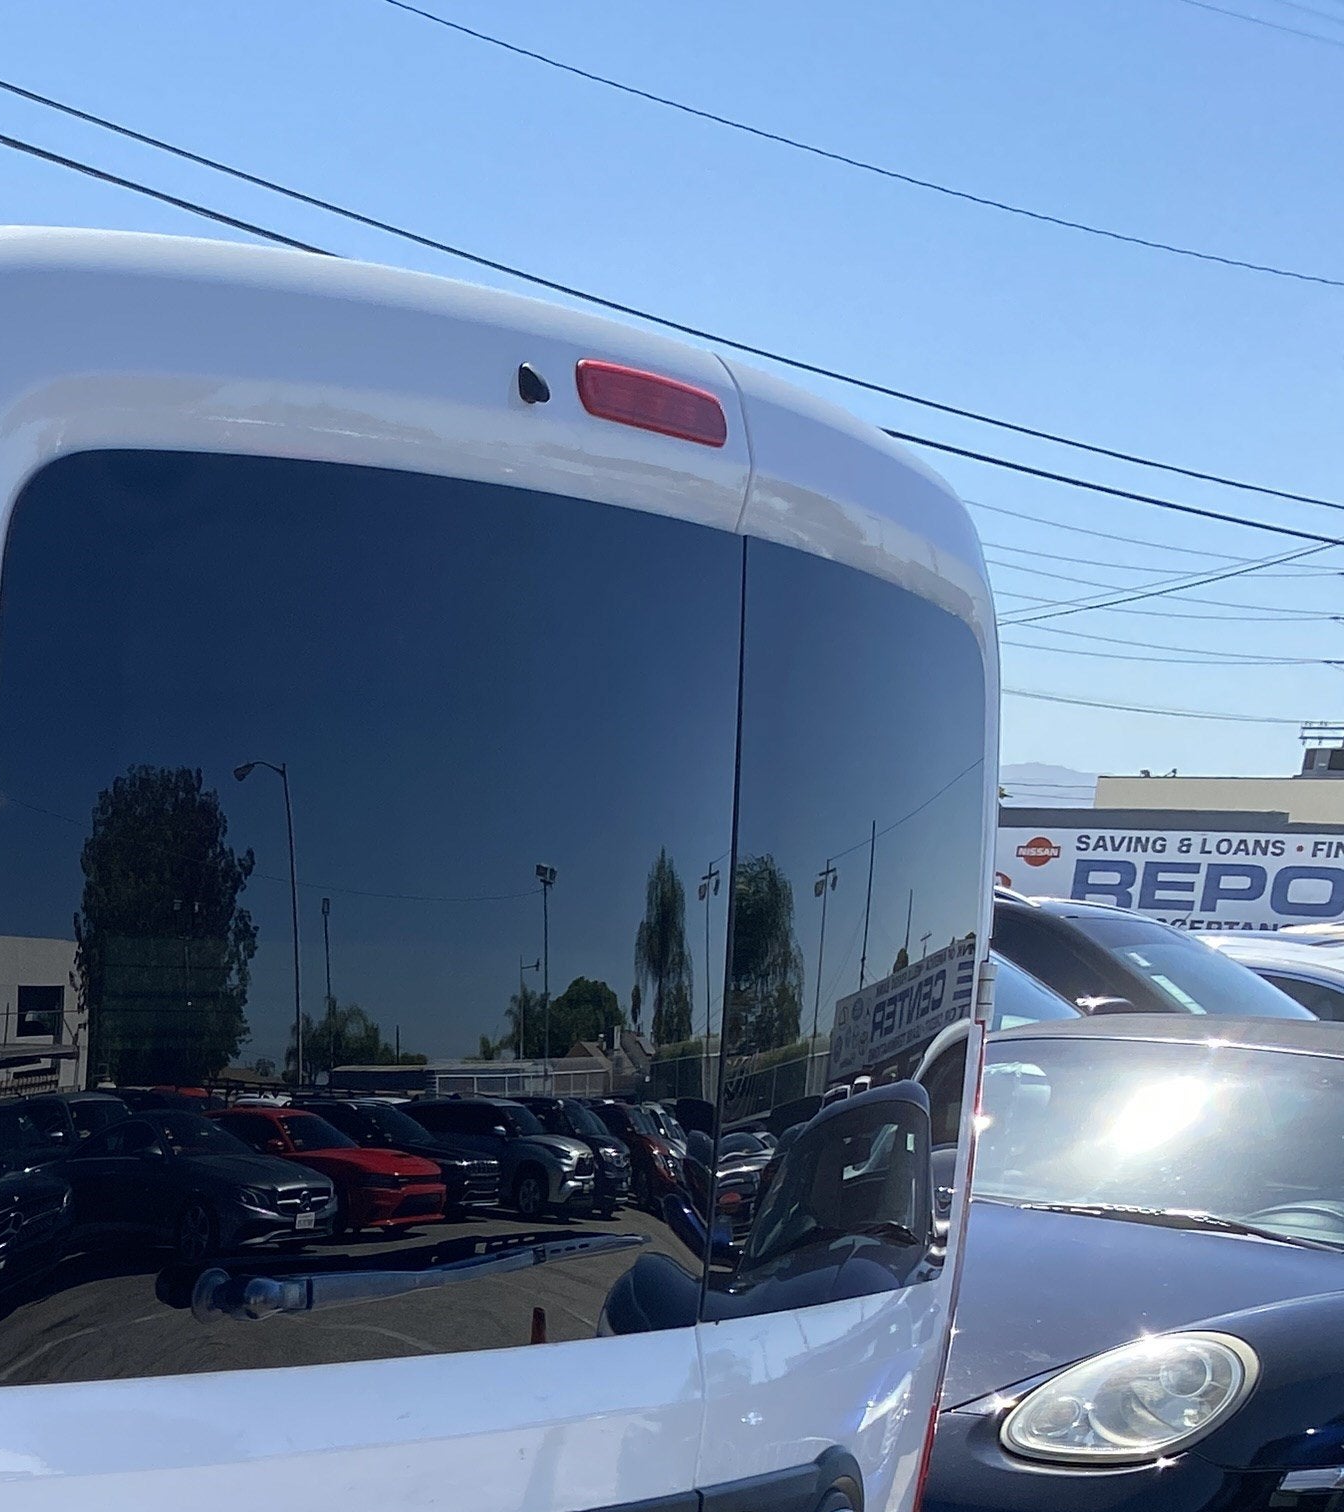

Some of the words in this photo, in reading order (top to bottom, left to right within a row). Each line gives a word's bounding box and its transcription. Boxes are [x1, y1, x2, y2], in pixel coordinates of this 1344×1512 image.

[1018, 847, 1059, 857] NISSAN
[1076, 834, 1167, 853] SAVING
[1177, 838, 1192, 854] &
[1200, 838, 1286, 857] LOANS
[1070, 859, 1344, 917] REPO
